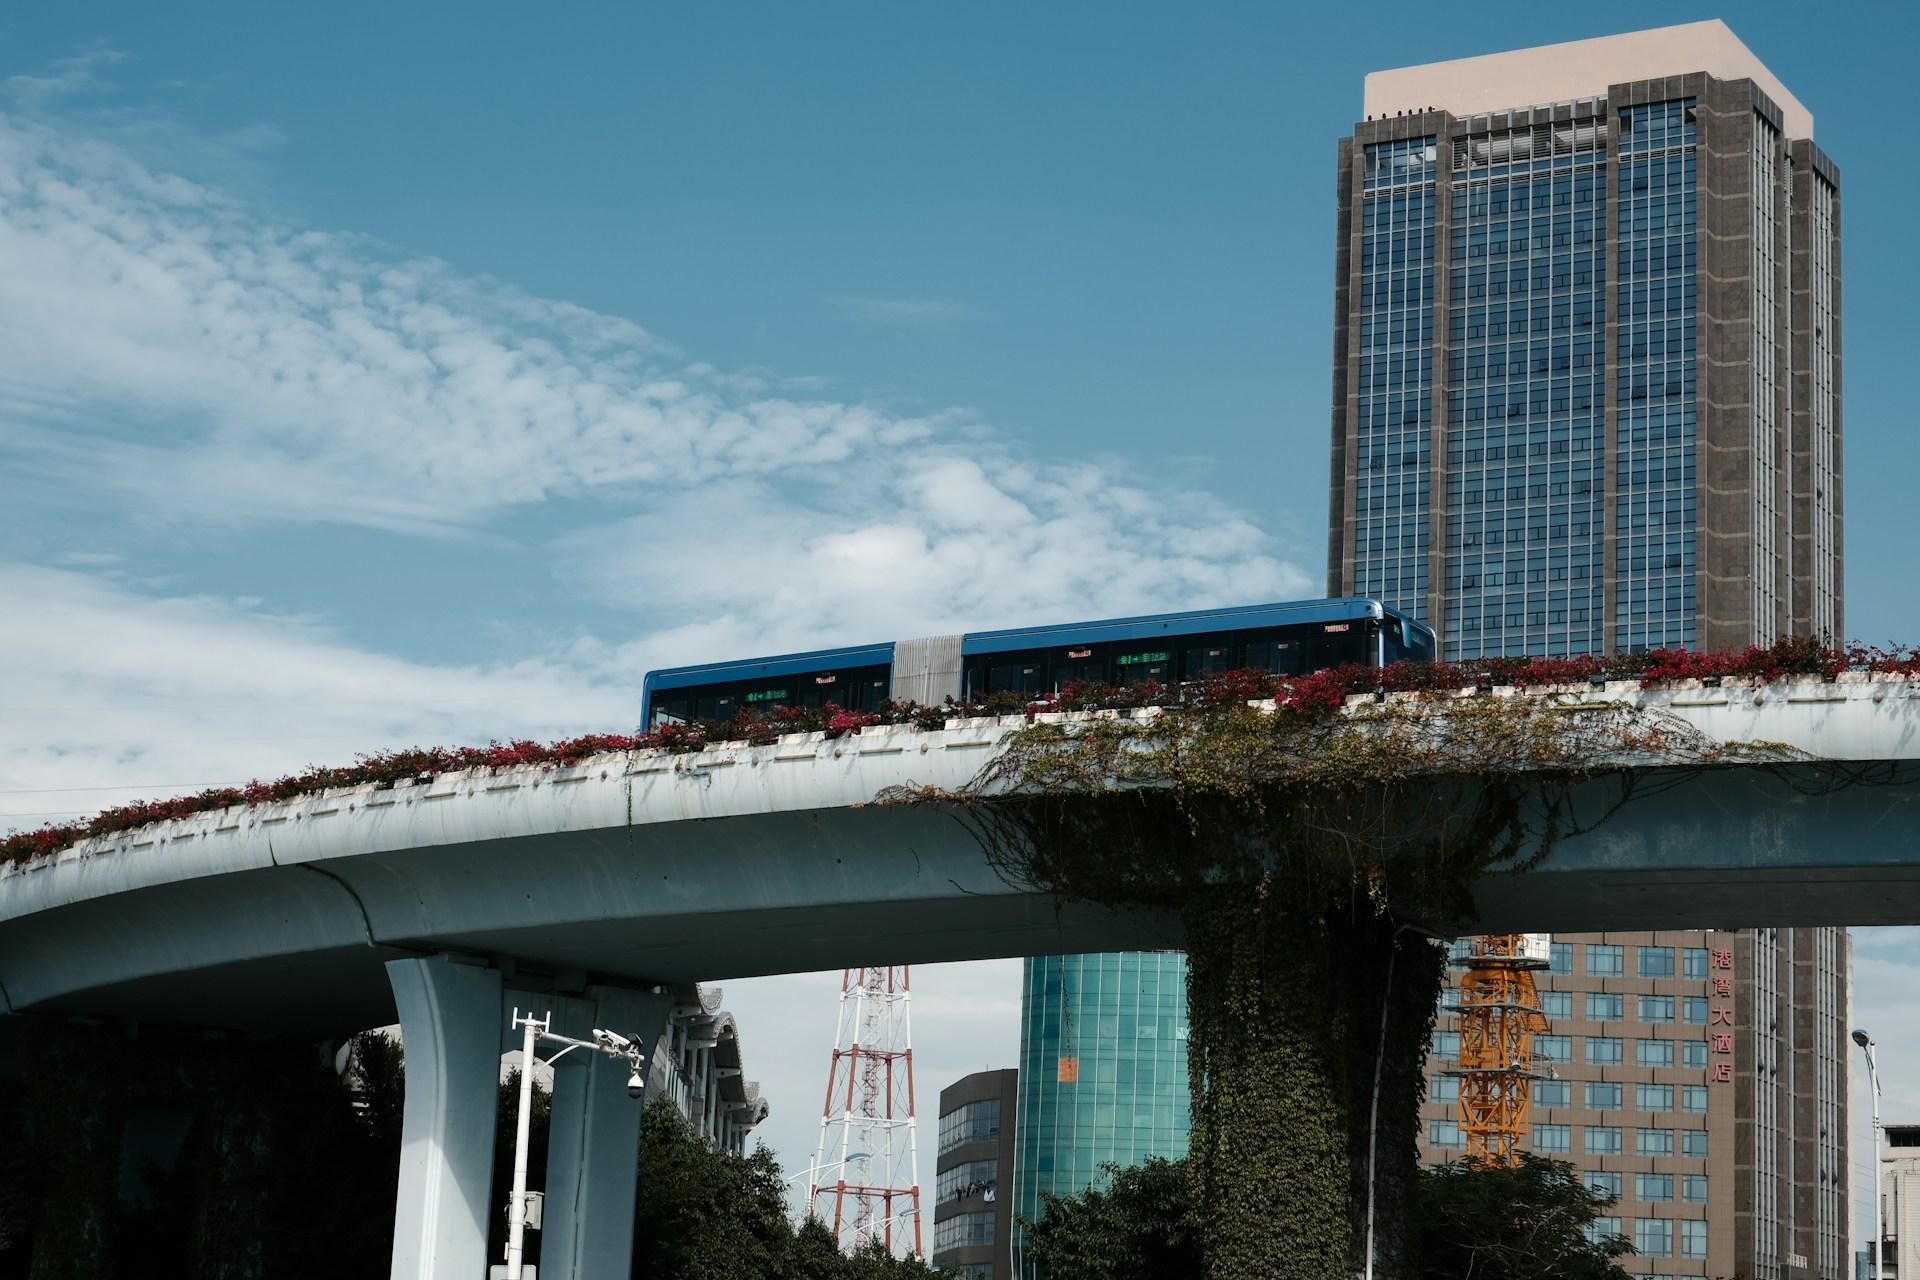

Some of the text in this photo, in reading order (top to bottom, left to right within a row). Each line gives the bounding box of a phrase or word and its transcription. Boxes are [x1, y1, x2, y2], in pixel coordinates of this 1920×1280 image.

[1711, 949, 1732, 1082] 港湾大酒店
